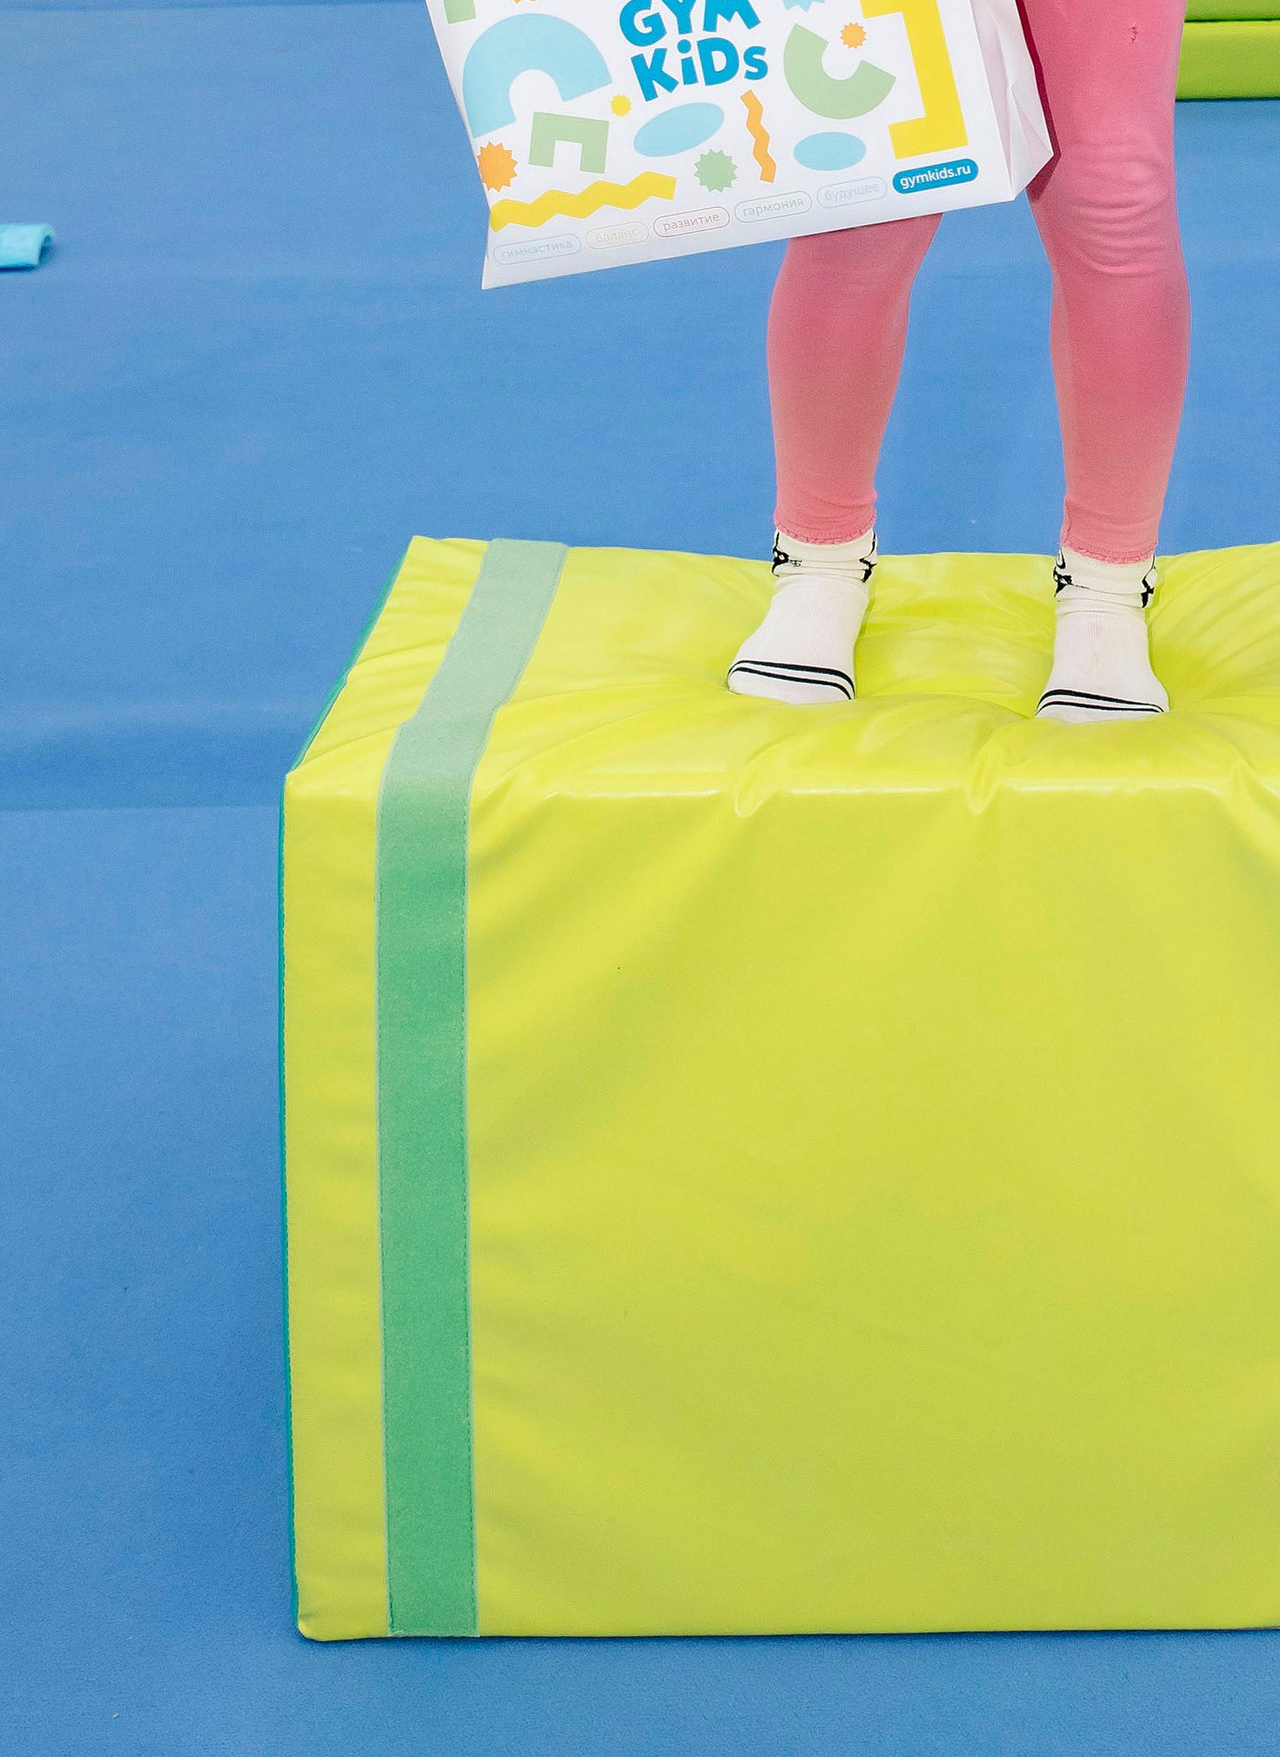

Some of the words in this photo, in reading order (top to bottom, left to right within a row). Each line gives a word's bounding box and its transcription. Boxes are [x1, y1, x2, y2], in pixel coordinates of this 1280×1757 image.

[630, 37, 769, 102] KiDs
[900, 164, 971, 190] gymkids.ru
[824, 182, 880, 201] будущее
[743, 198, 805, 217] гармония
[662, 212, 721, 233] развитие
[595, 226, 640, 243] баланс
[501, 239, 574, 259] гимнастика
